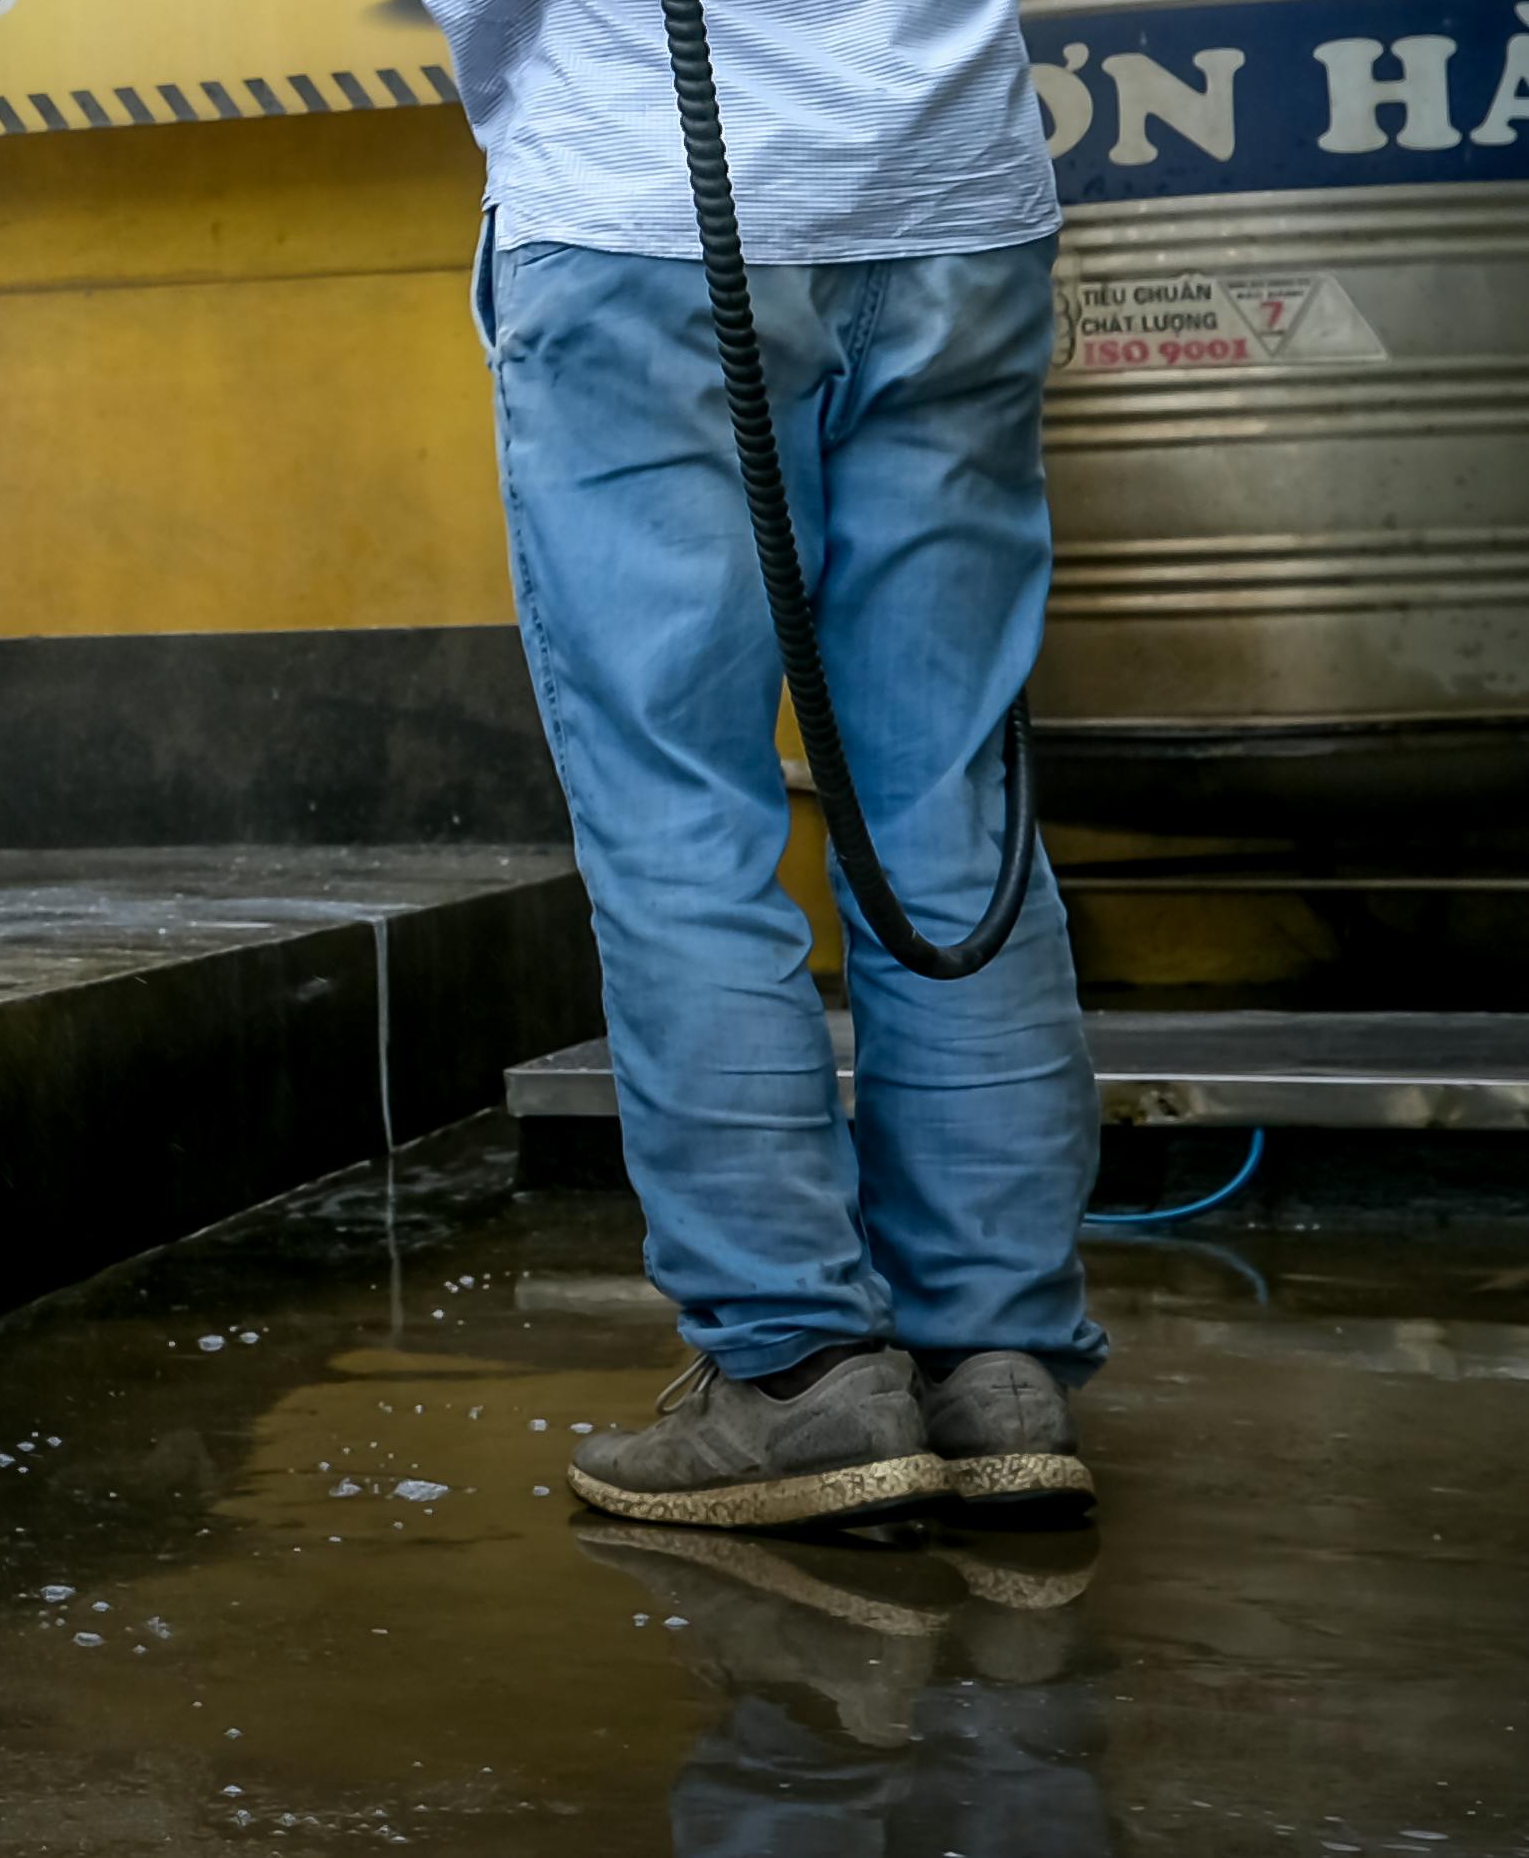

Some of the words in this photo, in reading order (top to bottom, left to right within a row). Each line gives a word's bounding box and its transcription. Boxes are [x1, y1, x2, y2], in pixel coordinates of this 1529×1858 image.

[1028, 41, 1247, 167] ƠN
[1083, 339, 1150, 367] ISO
[1158, 337, 1250, 366] 9001
